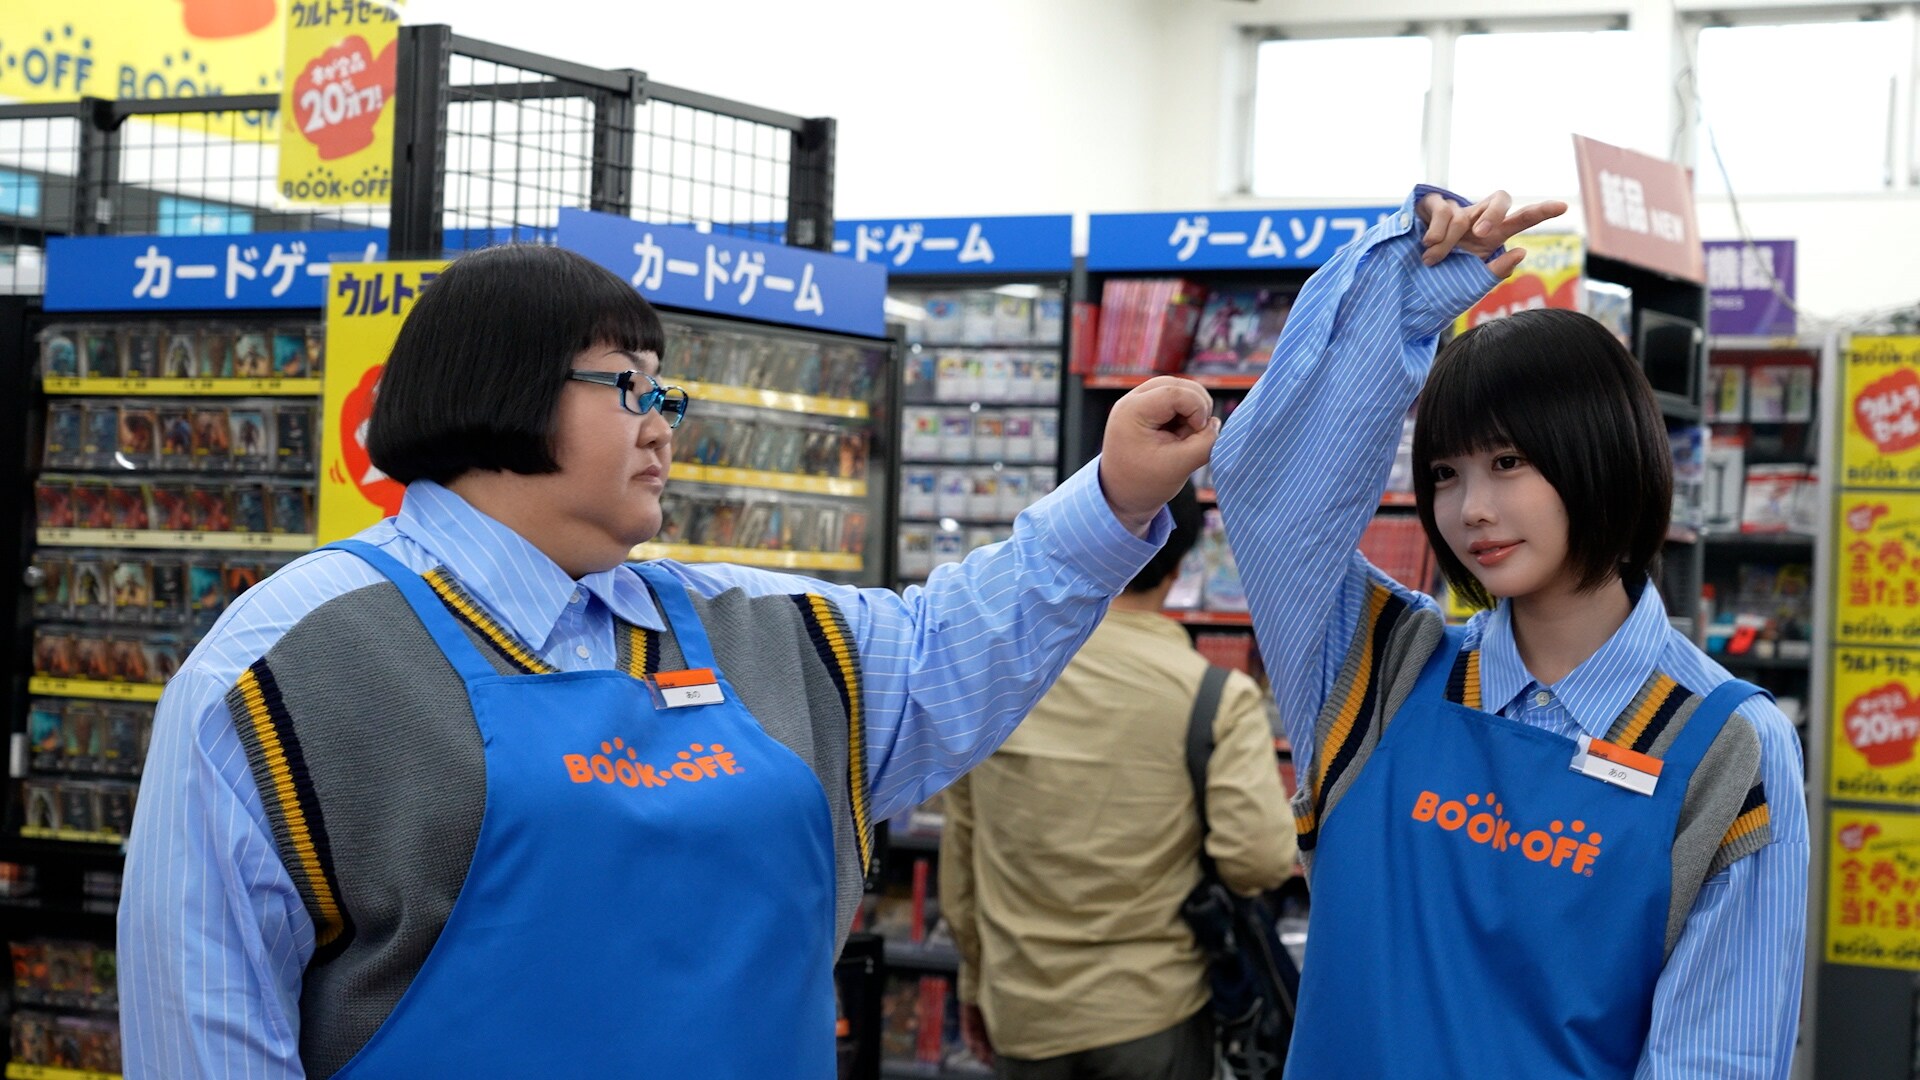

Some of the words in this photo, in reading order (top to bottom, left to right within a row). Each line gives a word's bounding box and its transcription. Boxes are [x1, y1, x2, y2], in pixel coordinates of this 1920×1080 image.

[1168, 214, 1391, 261] ゲームソフ
[632, 233, 824, 316] カードゲーム
[1608, 767, 1627, 780] あの
